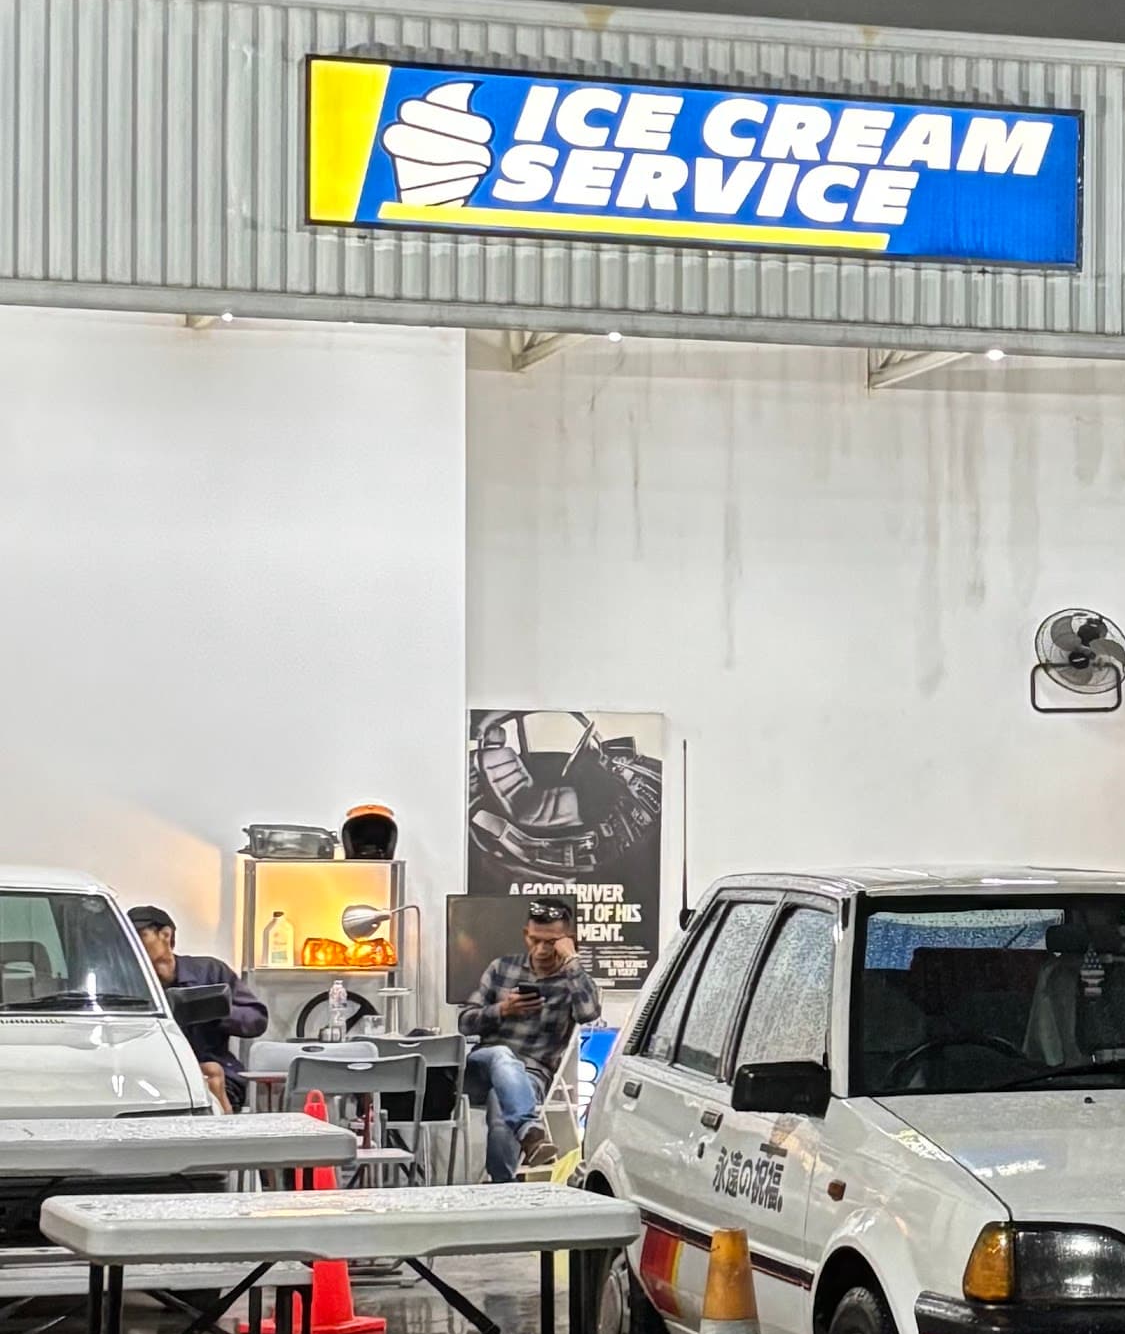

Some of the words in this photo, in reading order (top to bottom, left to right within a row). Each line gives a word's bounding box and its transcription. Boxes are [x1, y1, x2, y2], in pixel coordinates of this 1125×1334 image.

[513, 85, 684, 153] ICE
[701, 97, 1054, 178] CREAM
[491, 143, 921, 226] SERVICE
[577, 923, 624, 943] MENT.
[593, 904, 613, 922] OF
[614, 904, 642, 922] HIS
